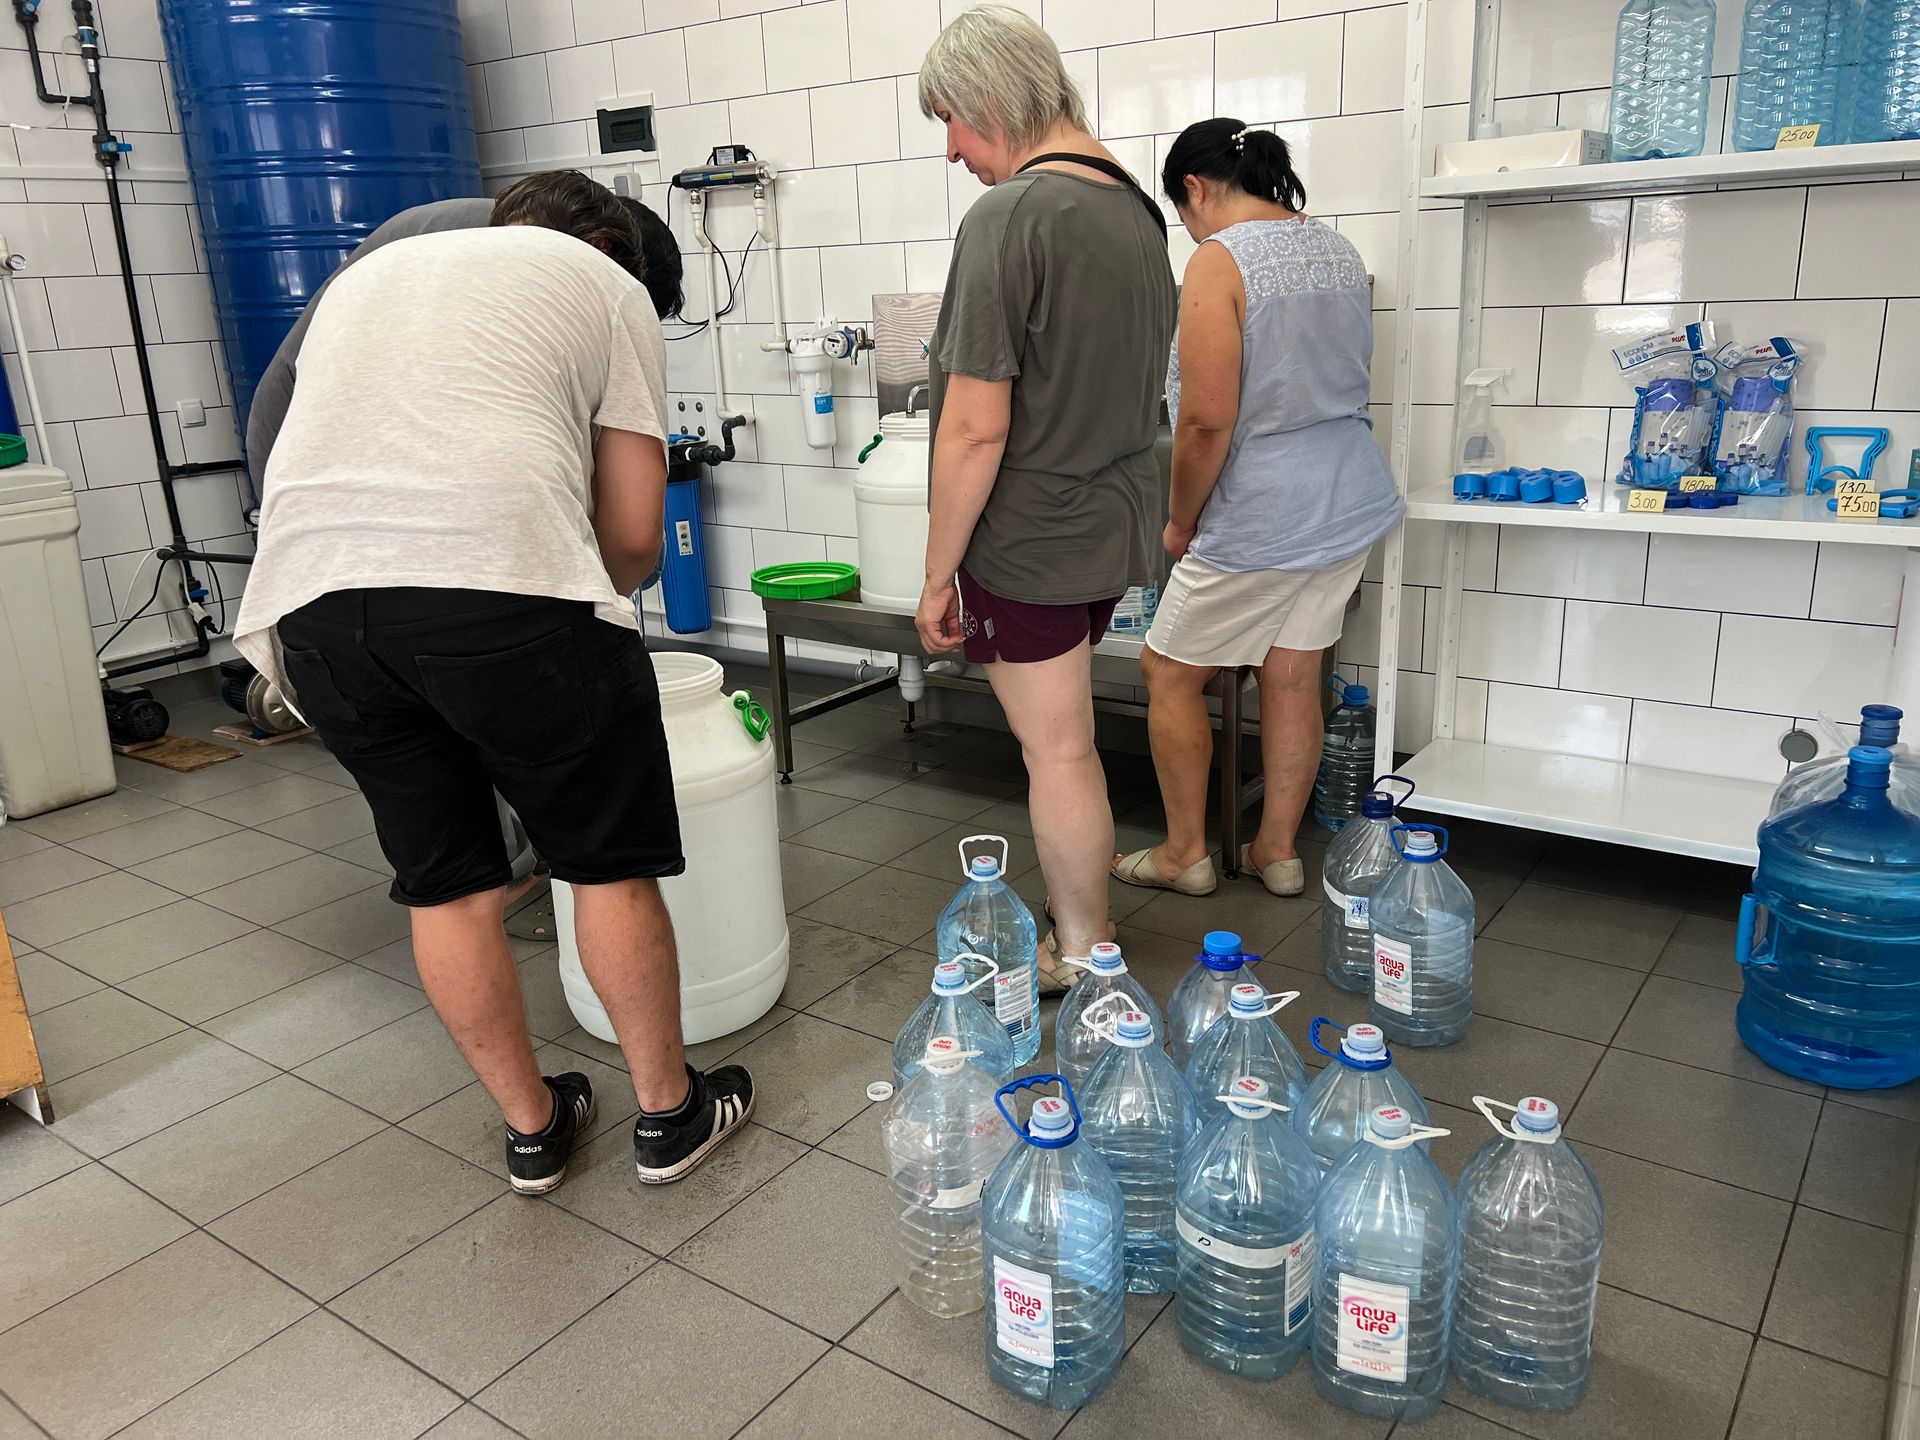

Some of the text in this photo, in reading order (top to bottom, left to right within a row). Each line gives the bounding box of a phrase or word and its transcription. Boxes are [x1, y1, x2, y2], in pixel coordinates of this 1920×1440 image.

[1671, 334, 1686, 343] PLUS
[1623, 342, 1655, 357] ECONOM
[1379, 955, 1405, 972] aqua
[636, 1129, 662, 1137] adidas
[514, 1145, 542, 1154] adidas
[1004, 1287, 1041, 1310] aqua
[1350, 1303, 1396, 1323] aqua
